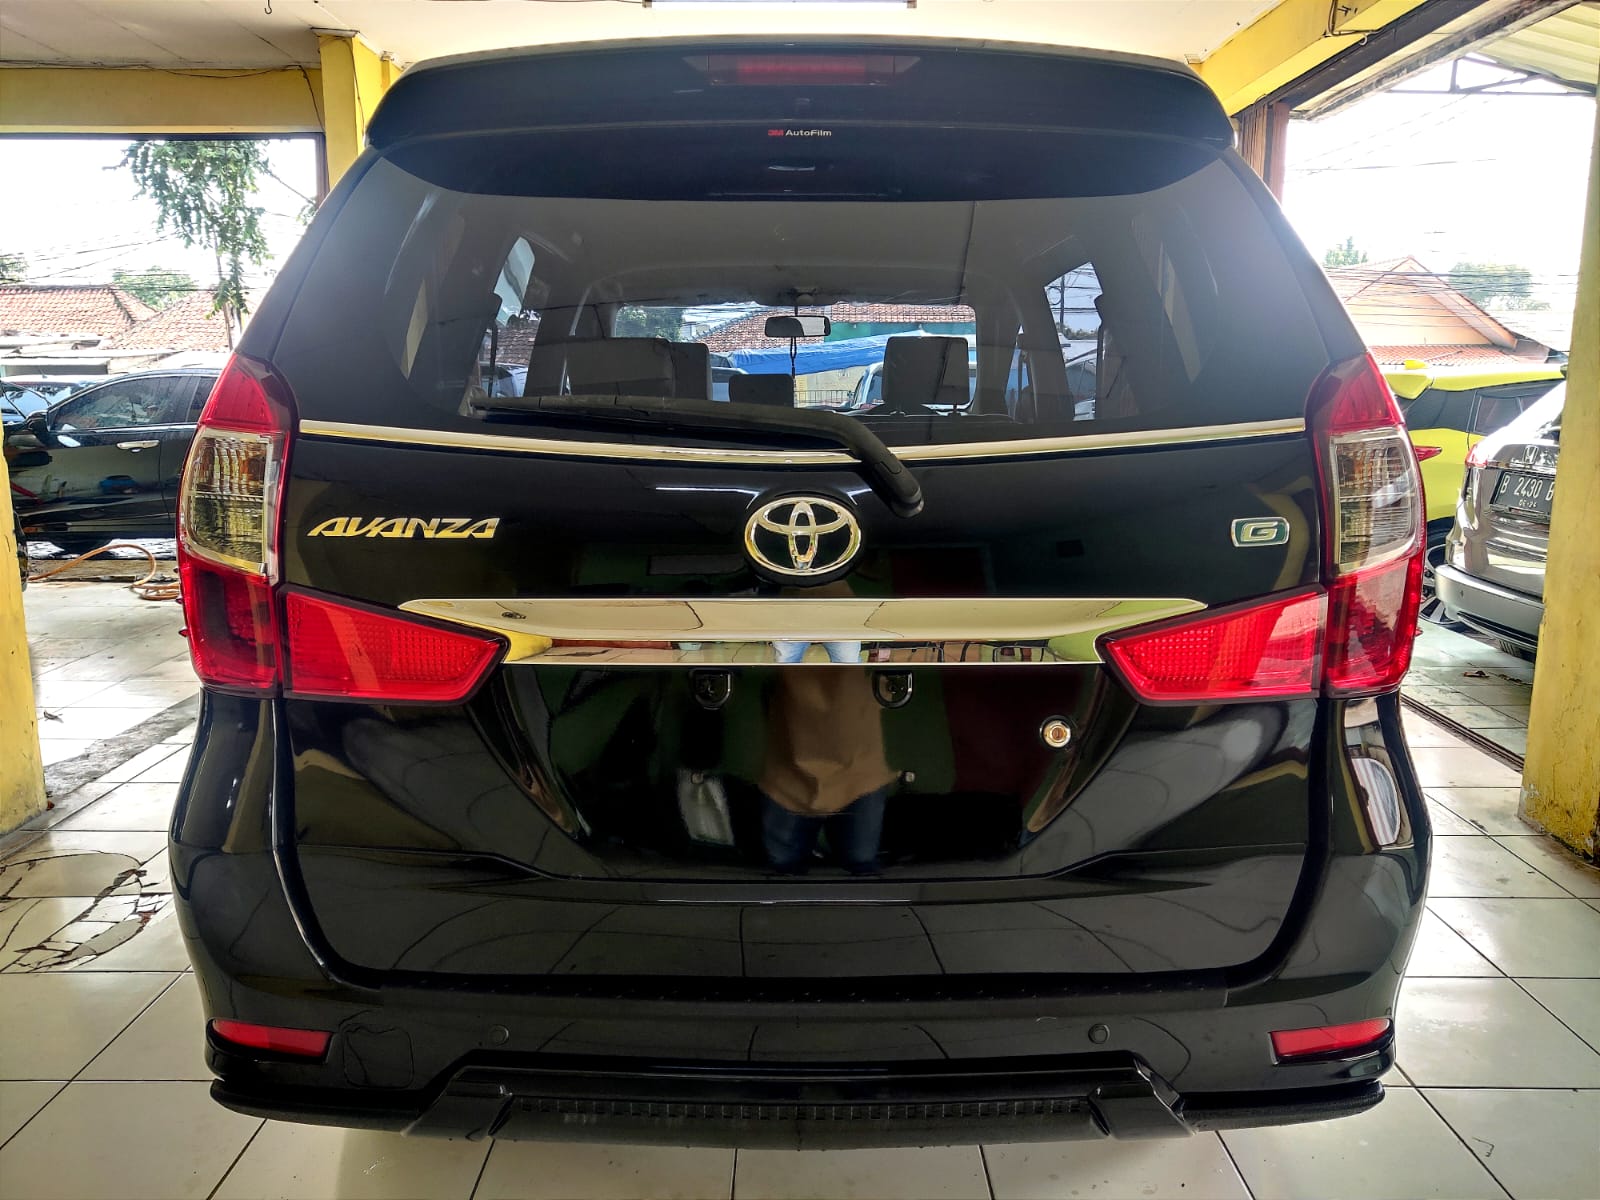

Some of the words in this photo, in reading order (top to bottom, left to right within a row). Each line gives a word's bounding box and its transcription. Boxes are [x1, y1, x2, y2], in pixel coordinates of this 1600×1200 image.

[785, 129, 832, 137] AutoFilm
[1500, 475, 1511, 494] B
[1513, 477, 1543, 499] 2430
[307, 517, 500, 539] AVANZA
[1241, 521, 1278, 542] G
